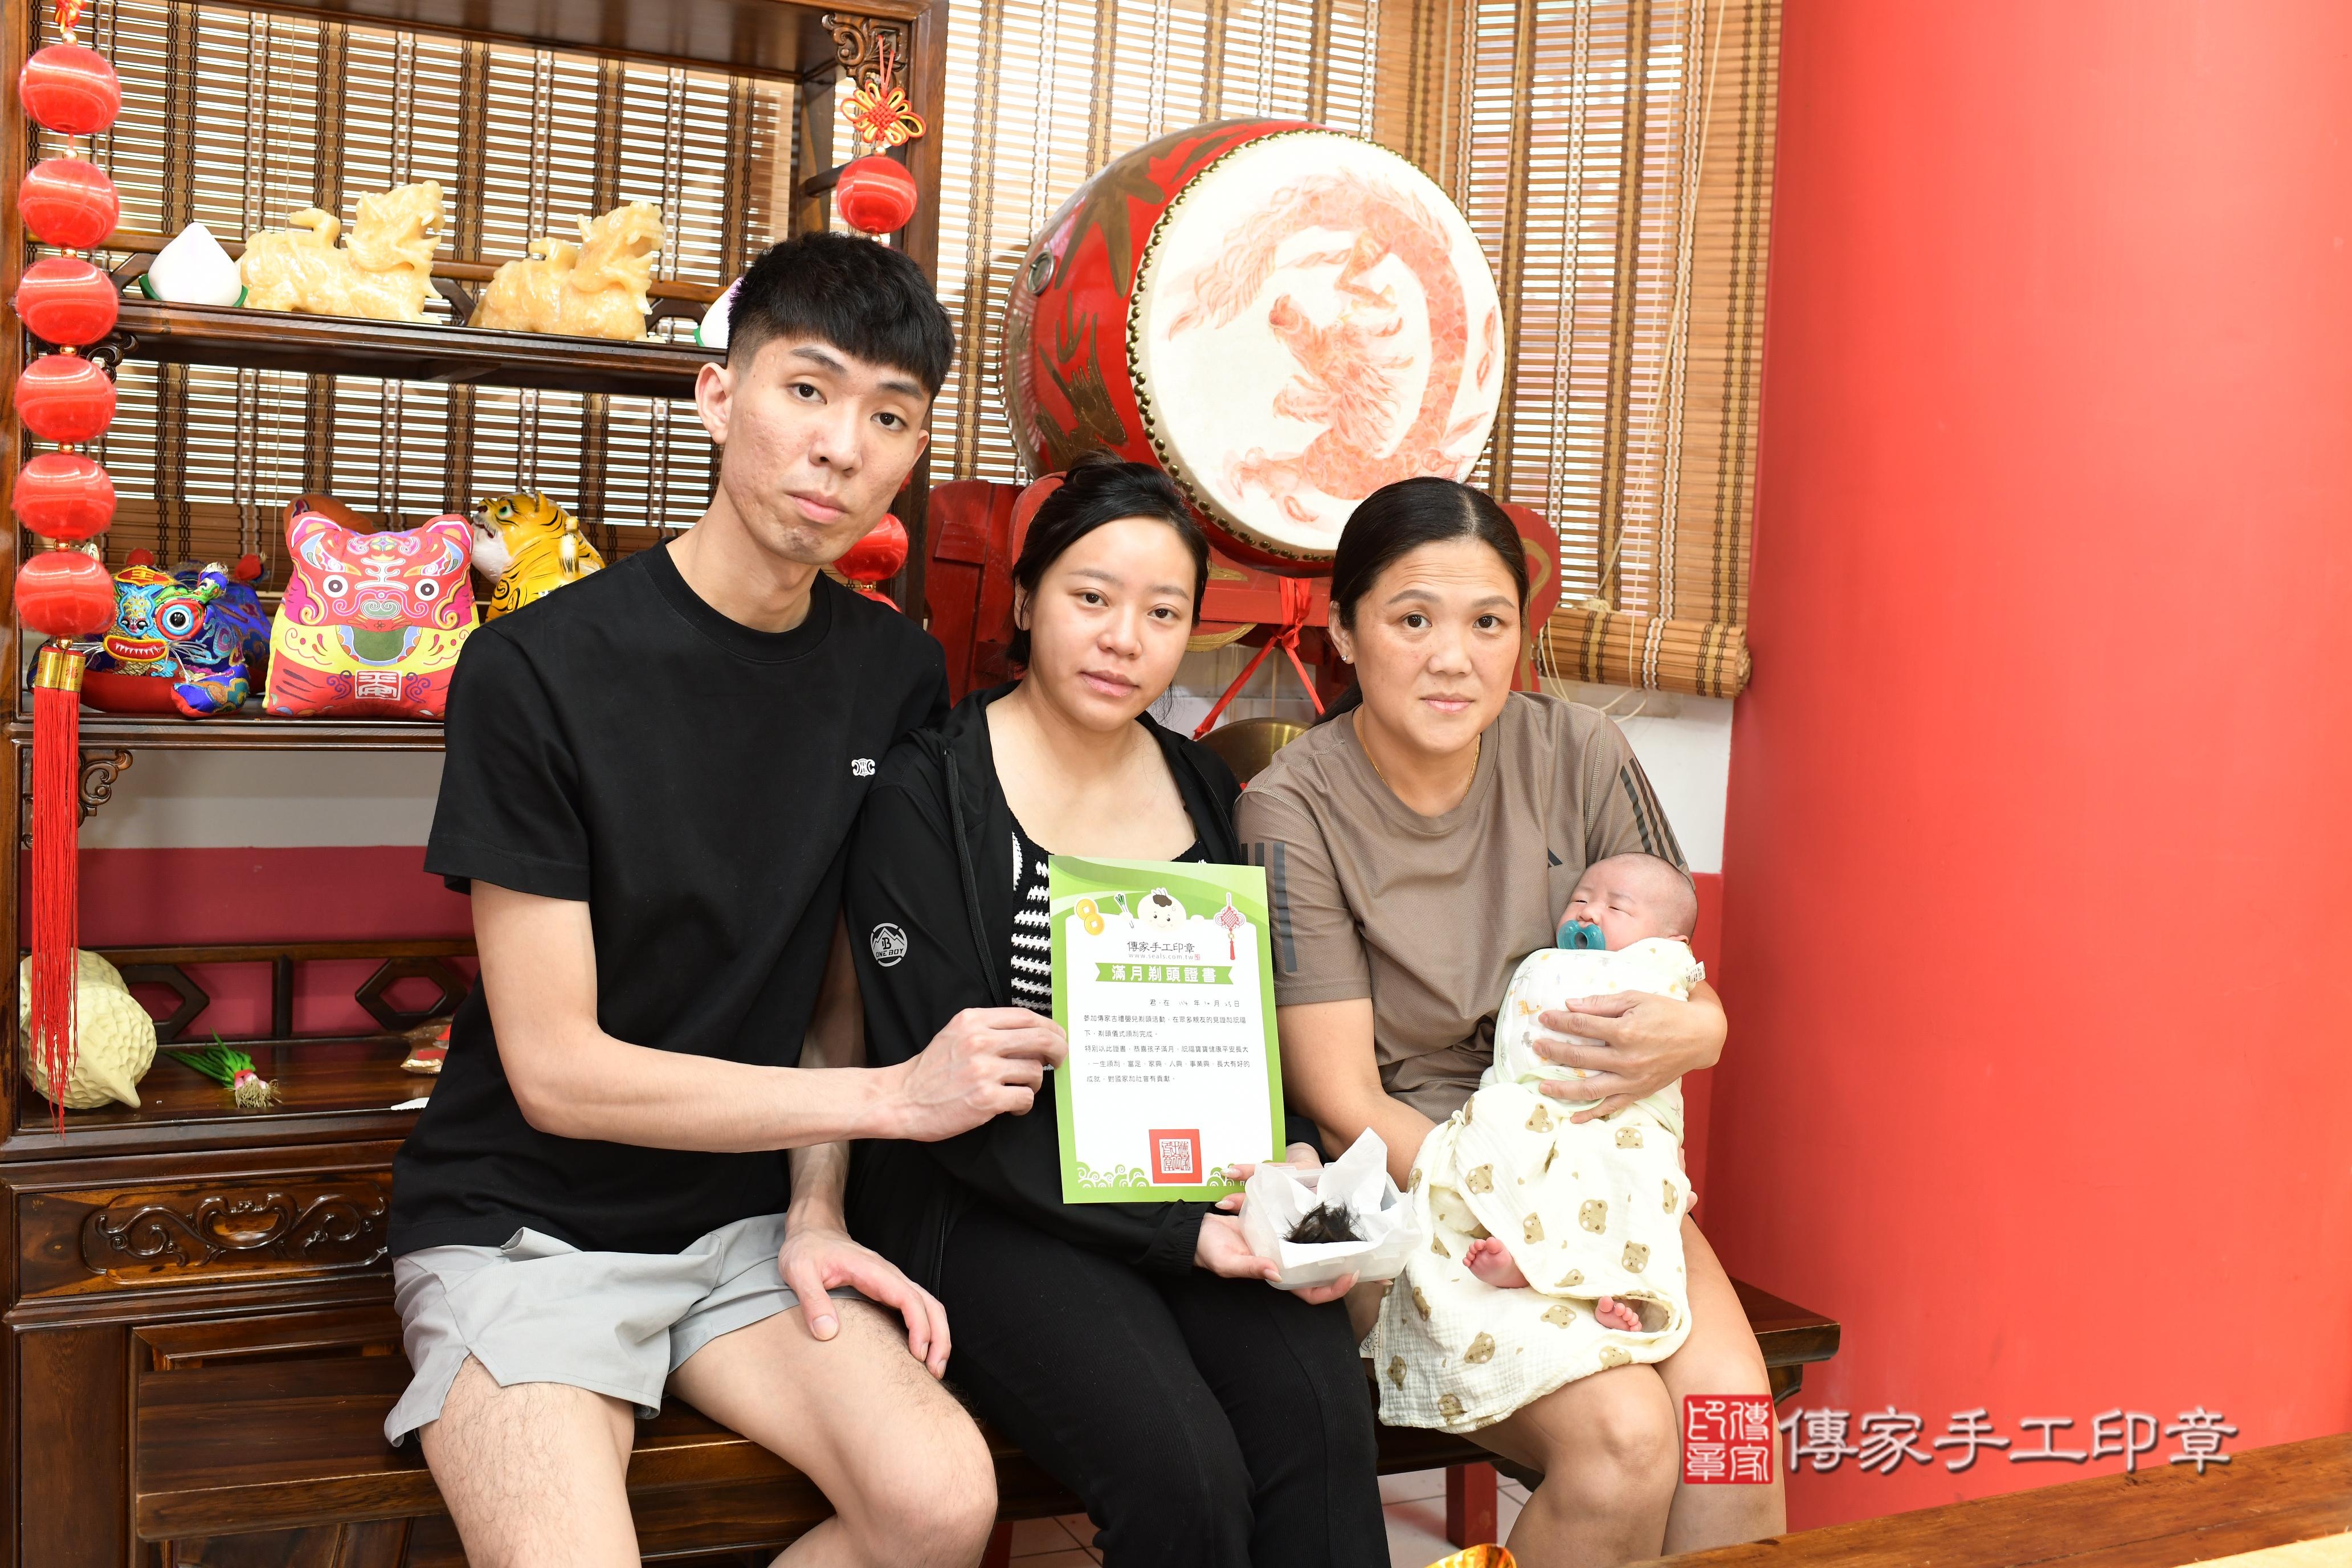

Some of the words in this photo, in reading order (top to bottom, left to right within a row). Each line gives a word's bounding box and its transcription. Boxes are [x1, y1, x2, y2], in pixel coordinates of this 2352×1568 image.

[1127, 941, 1195, 953] 傳家手工印章
[1112, 965, 1216, 983] 滿月剃頭證書
